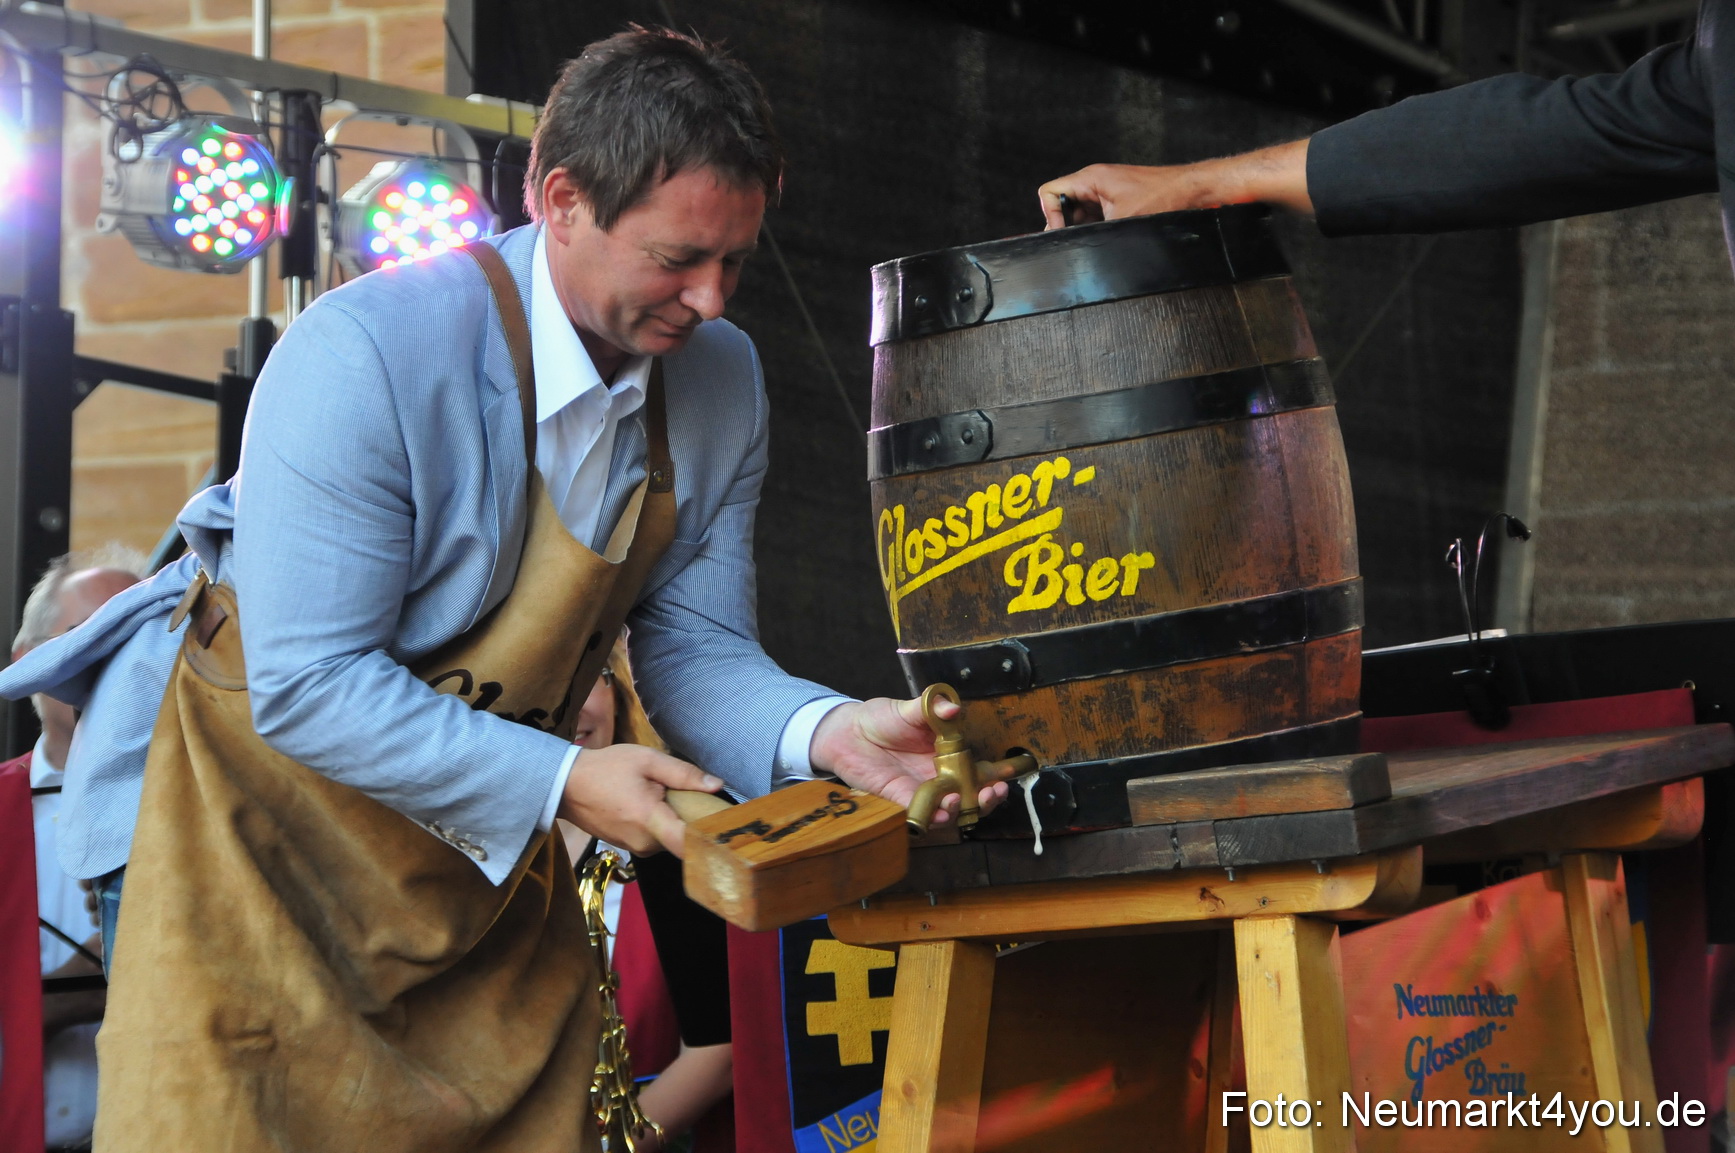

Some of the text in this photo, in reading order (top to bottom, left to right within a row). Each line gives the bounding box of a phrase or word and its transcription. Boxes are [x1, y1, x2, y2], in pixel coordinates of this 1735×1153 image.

[877, 456, 1096, 643] Glossner-
[1003, 533, 1156, 615] Bier
[1393, 983, 1519, 1020] Neumarkter
[1404, 1021, 1508, 1107] Glossner-
[1464, 1056, 1528, 1097] Bräu
